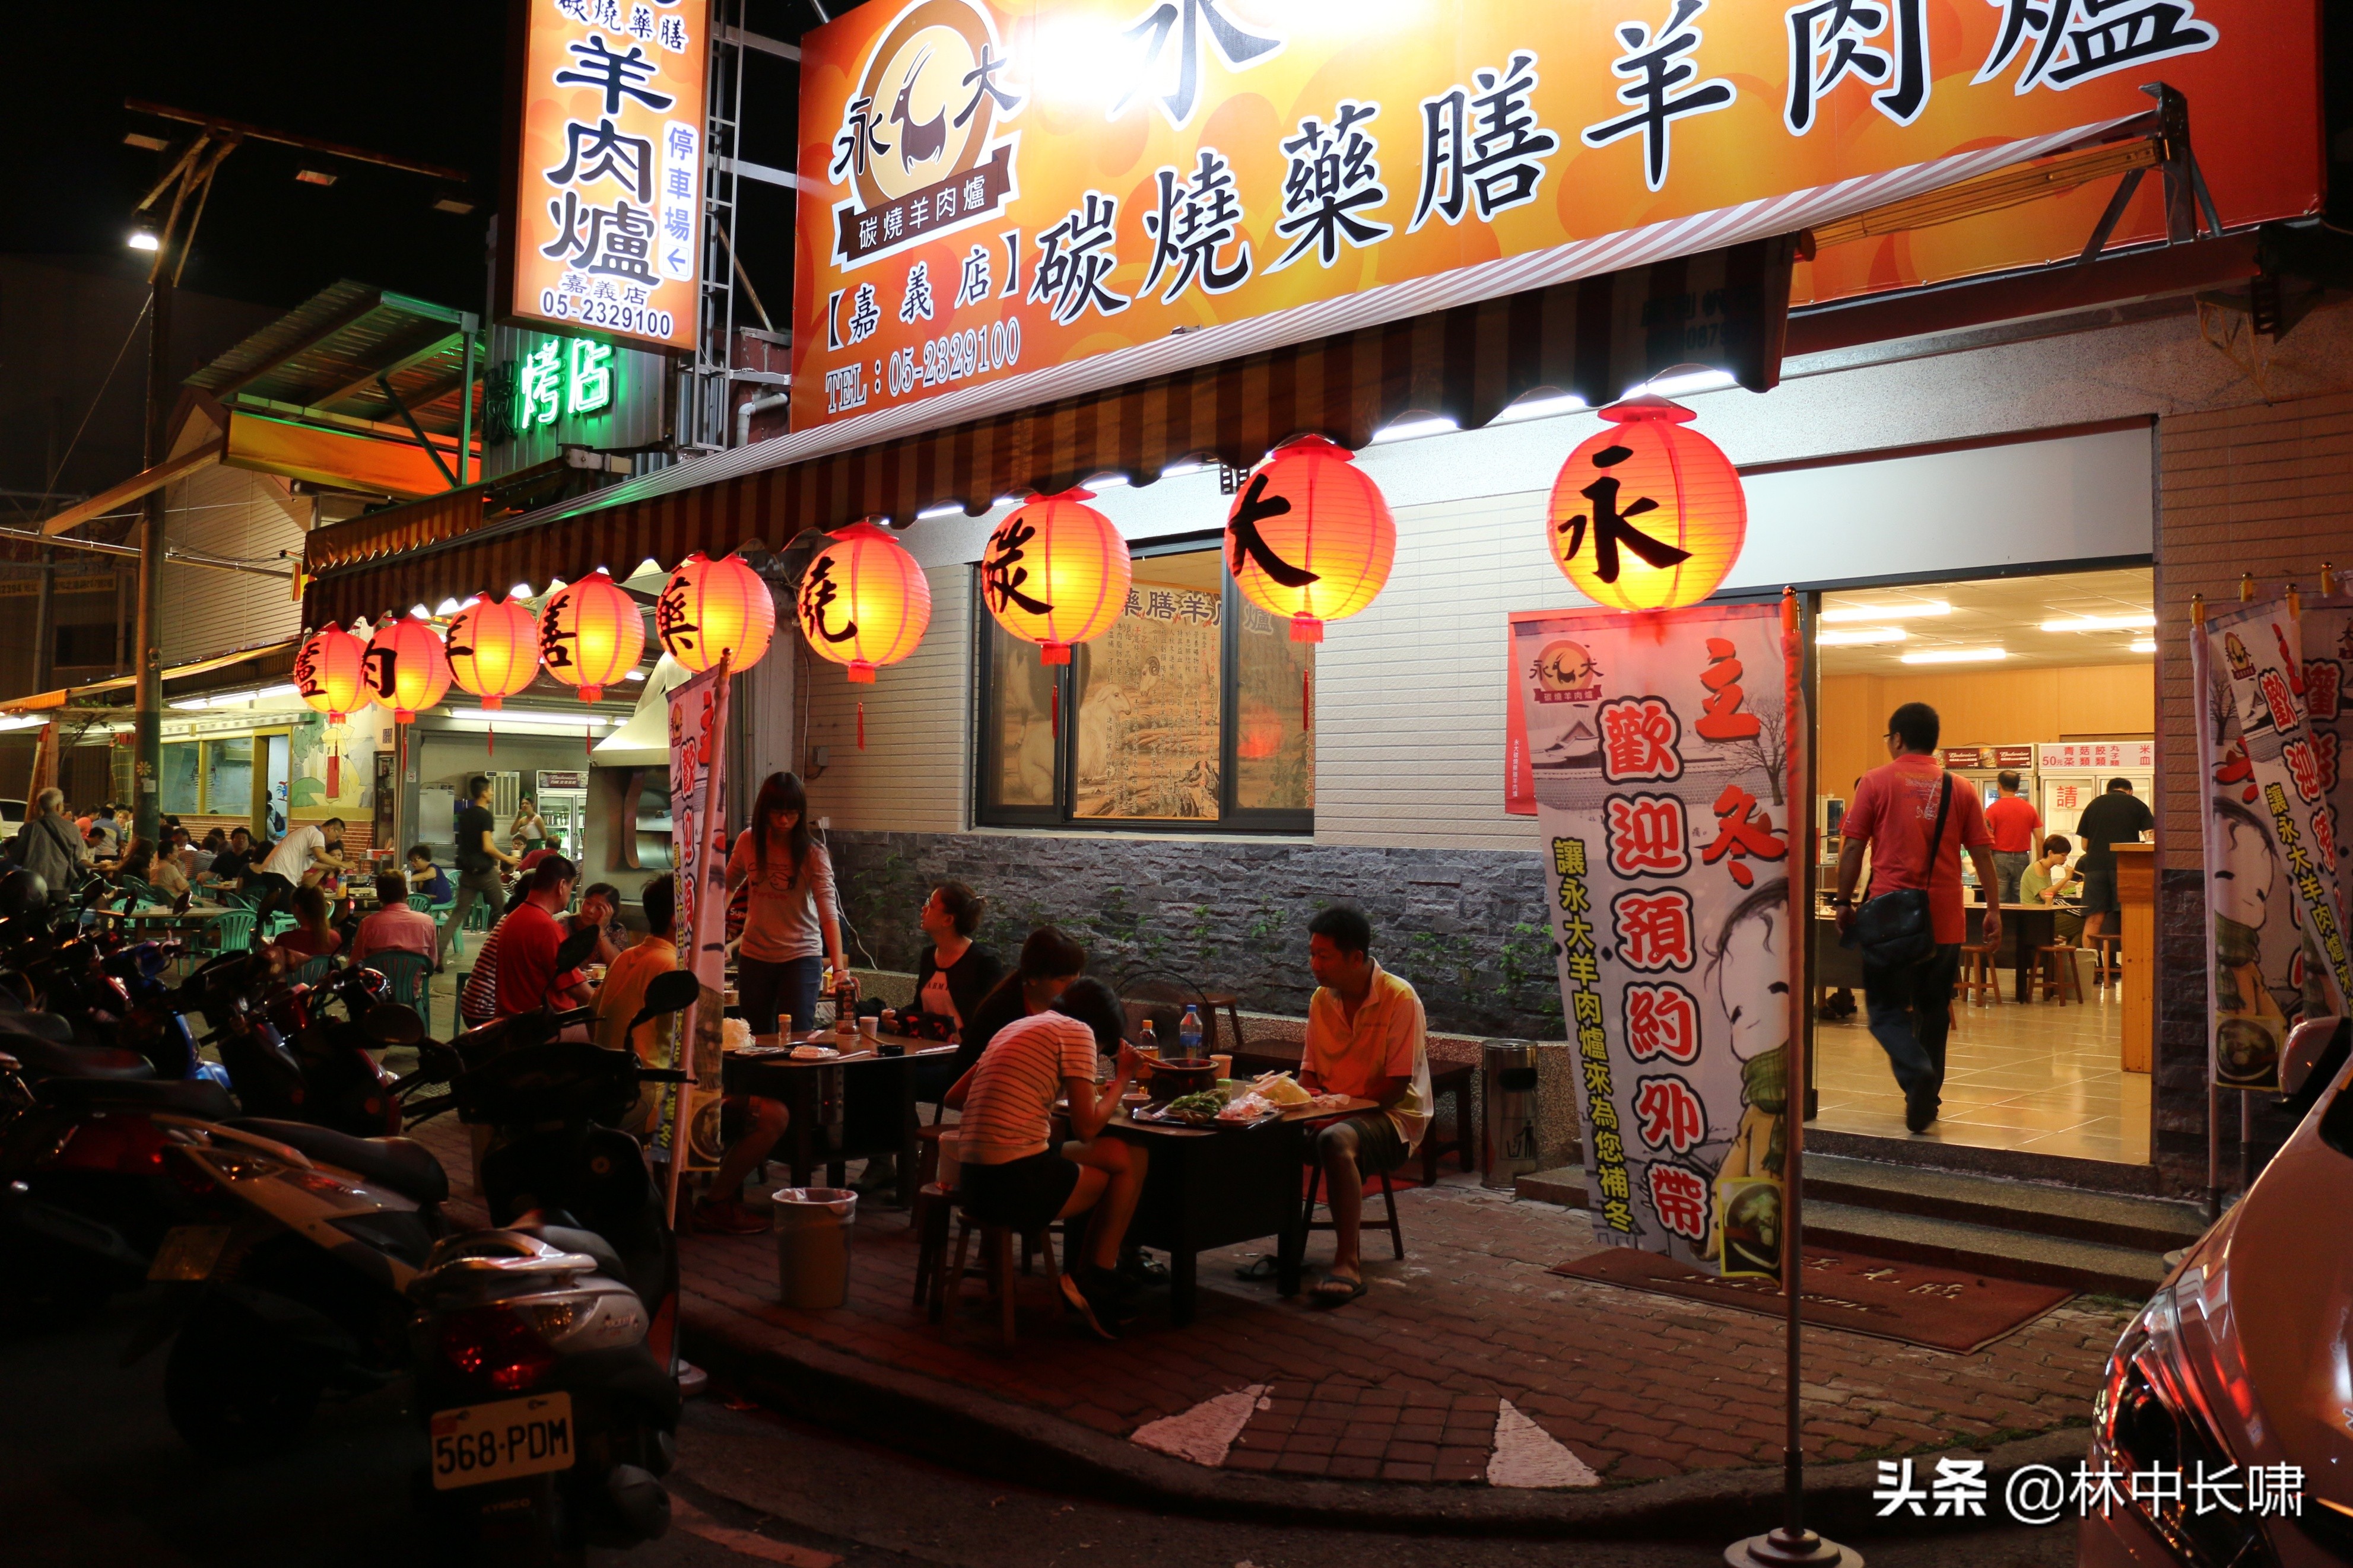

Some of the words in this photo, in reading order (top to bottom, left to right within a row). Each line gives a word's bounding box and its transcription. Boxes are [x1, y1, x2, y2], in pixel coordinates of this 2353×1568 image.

[543, 35, 675, 286] 羊肉爐
[664, 126, 694, 241] 停車場
[858, 174, 987, 250] 碳燒羊肉爐
[543, 291, 670, 336] 05-2329100
[561, 274, 647, 306] 嘉義店
[1228, 473, 1322, 587] 大
[1557, 445, 1694, 584] 永
[361, 638, 398, 698] 肉
[1543, 690, 1594, 701] 碳燒羊肉爐
[1694, 637, 1785, 886] 立冬
[2064, 746, 2075, 766] 青菜
[2079, 746, 2091, 766] 菇類
[2095, 745, 2106, 766] 餃類
[2110, 745, 2120, 766] 丸子類
[2139, 745, 2151, 766] 米血
[2056, 785, 2078, 808] 請
[1599, 701, 1705, 1239] 歡迎預約外帶
[1553, 837, 1635, 1234] 讓永大羊肉爐來為您補冬
